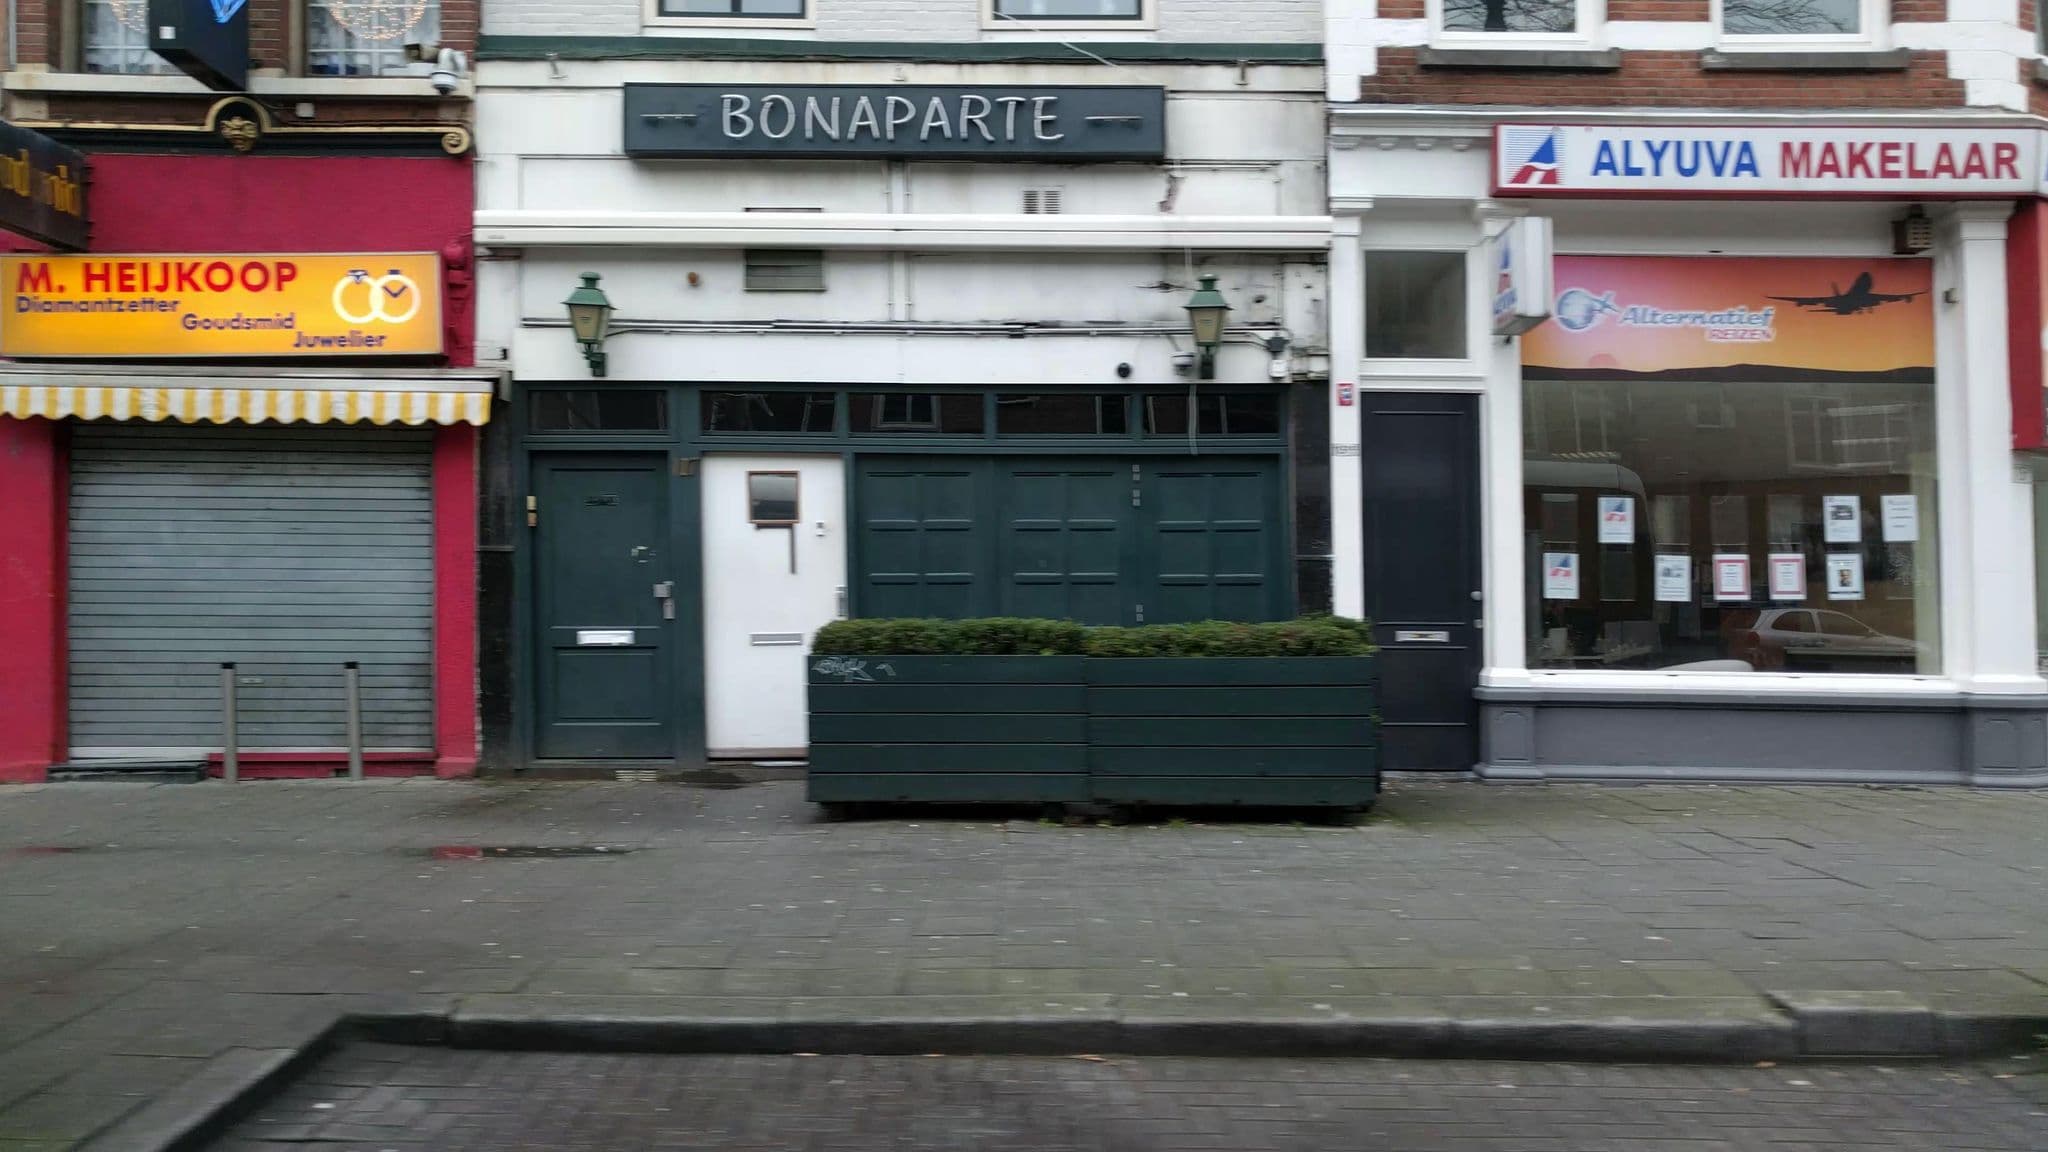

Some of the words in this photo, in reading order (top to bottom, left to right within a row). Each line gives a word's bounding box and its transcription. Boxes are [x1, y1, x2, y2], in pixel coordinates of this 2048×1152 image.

[720, 93, 1065, 143] BONAPARTE
[1592, 139, 1760, 178] ALYUVA
[1780, 142, 2020, 180] MAKELAAR
[17, 262, 66, 293] M.
[83, 261, 297, 293] HEIJKOOP
[16, 296, 180, 313] Diamantzetter
[182, 313, 295, 330] Goudsmid
[1622, 307, 1773, 327] Alternatief
[293, 330, 387, 348] Juwelier
[1711, 328, 1771, 340] REIZEN
